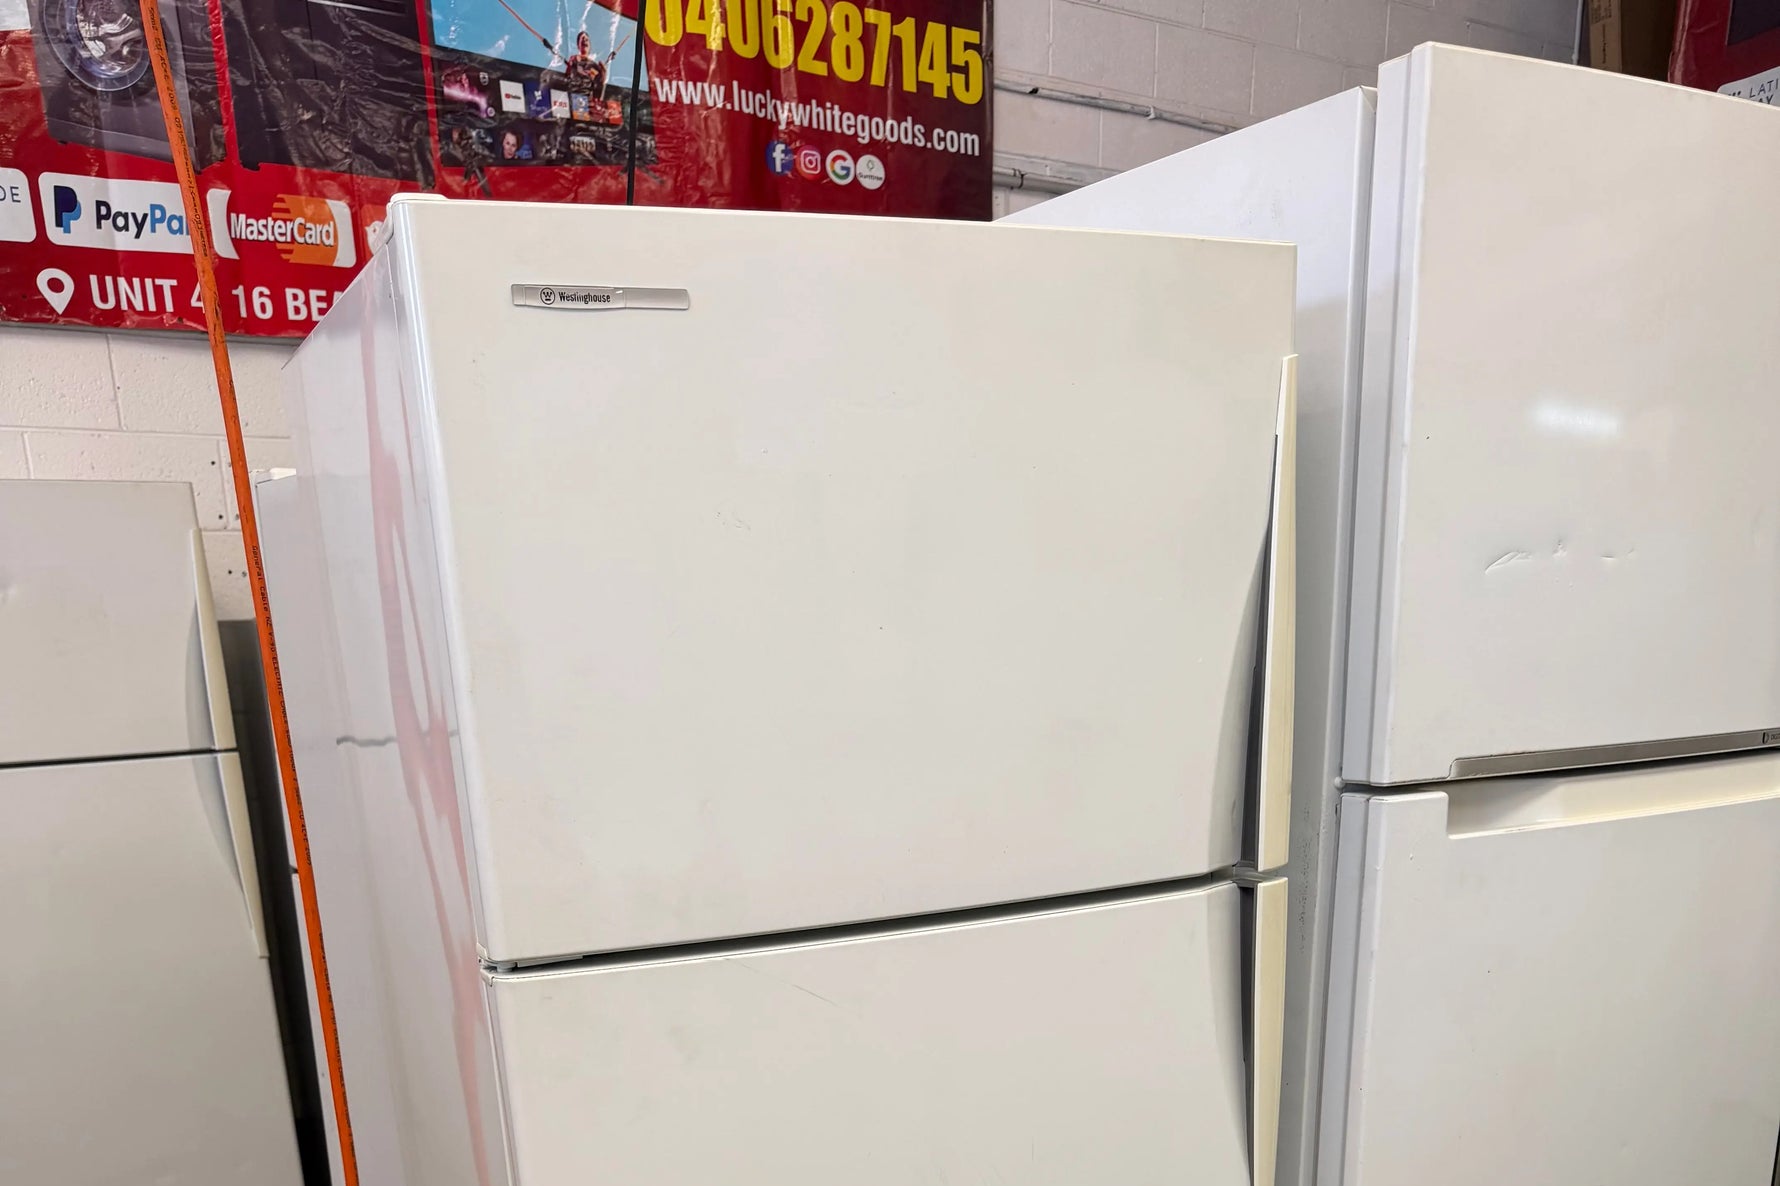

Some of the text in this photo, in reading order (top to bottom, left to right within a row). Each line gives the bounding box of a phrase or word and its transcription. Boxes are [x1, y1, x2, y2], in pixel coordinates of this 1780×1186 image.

[655, 77, 980, 156] www.luckywhitegoods.com
[95, 199, 191, 239] PayPa
[230, 212, 335, 247] MasterCard
[89, 274, 178, 313] UNIT
[231, 284, 274, 321] 16
[285, 286, 344, 322] BE
[558, 291, 611, 305] Westinghouse
